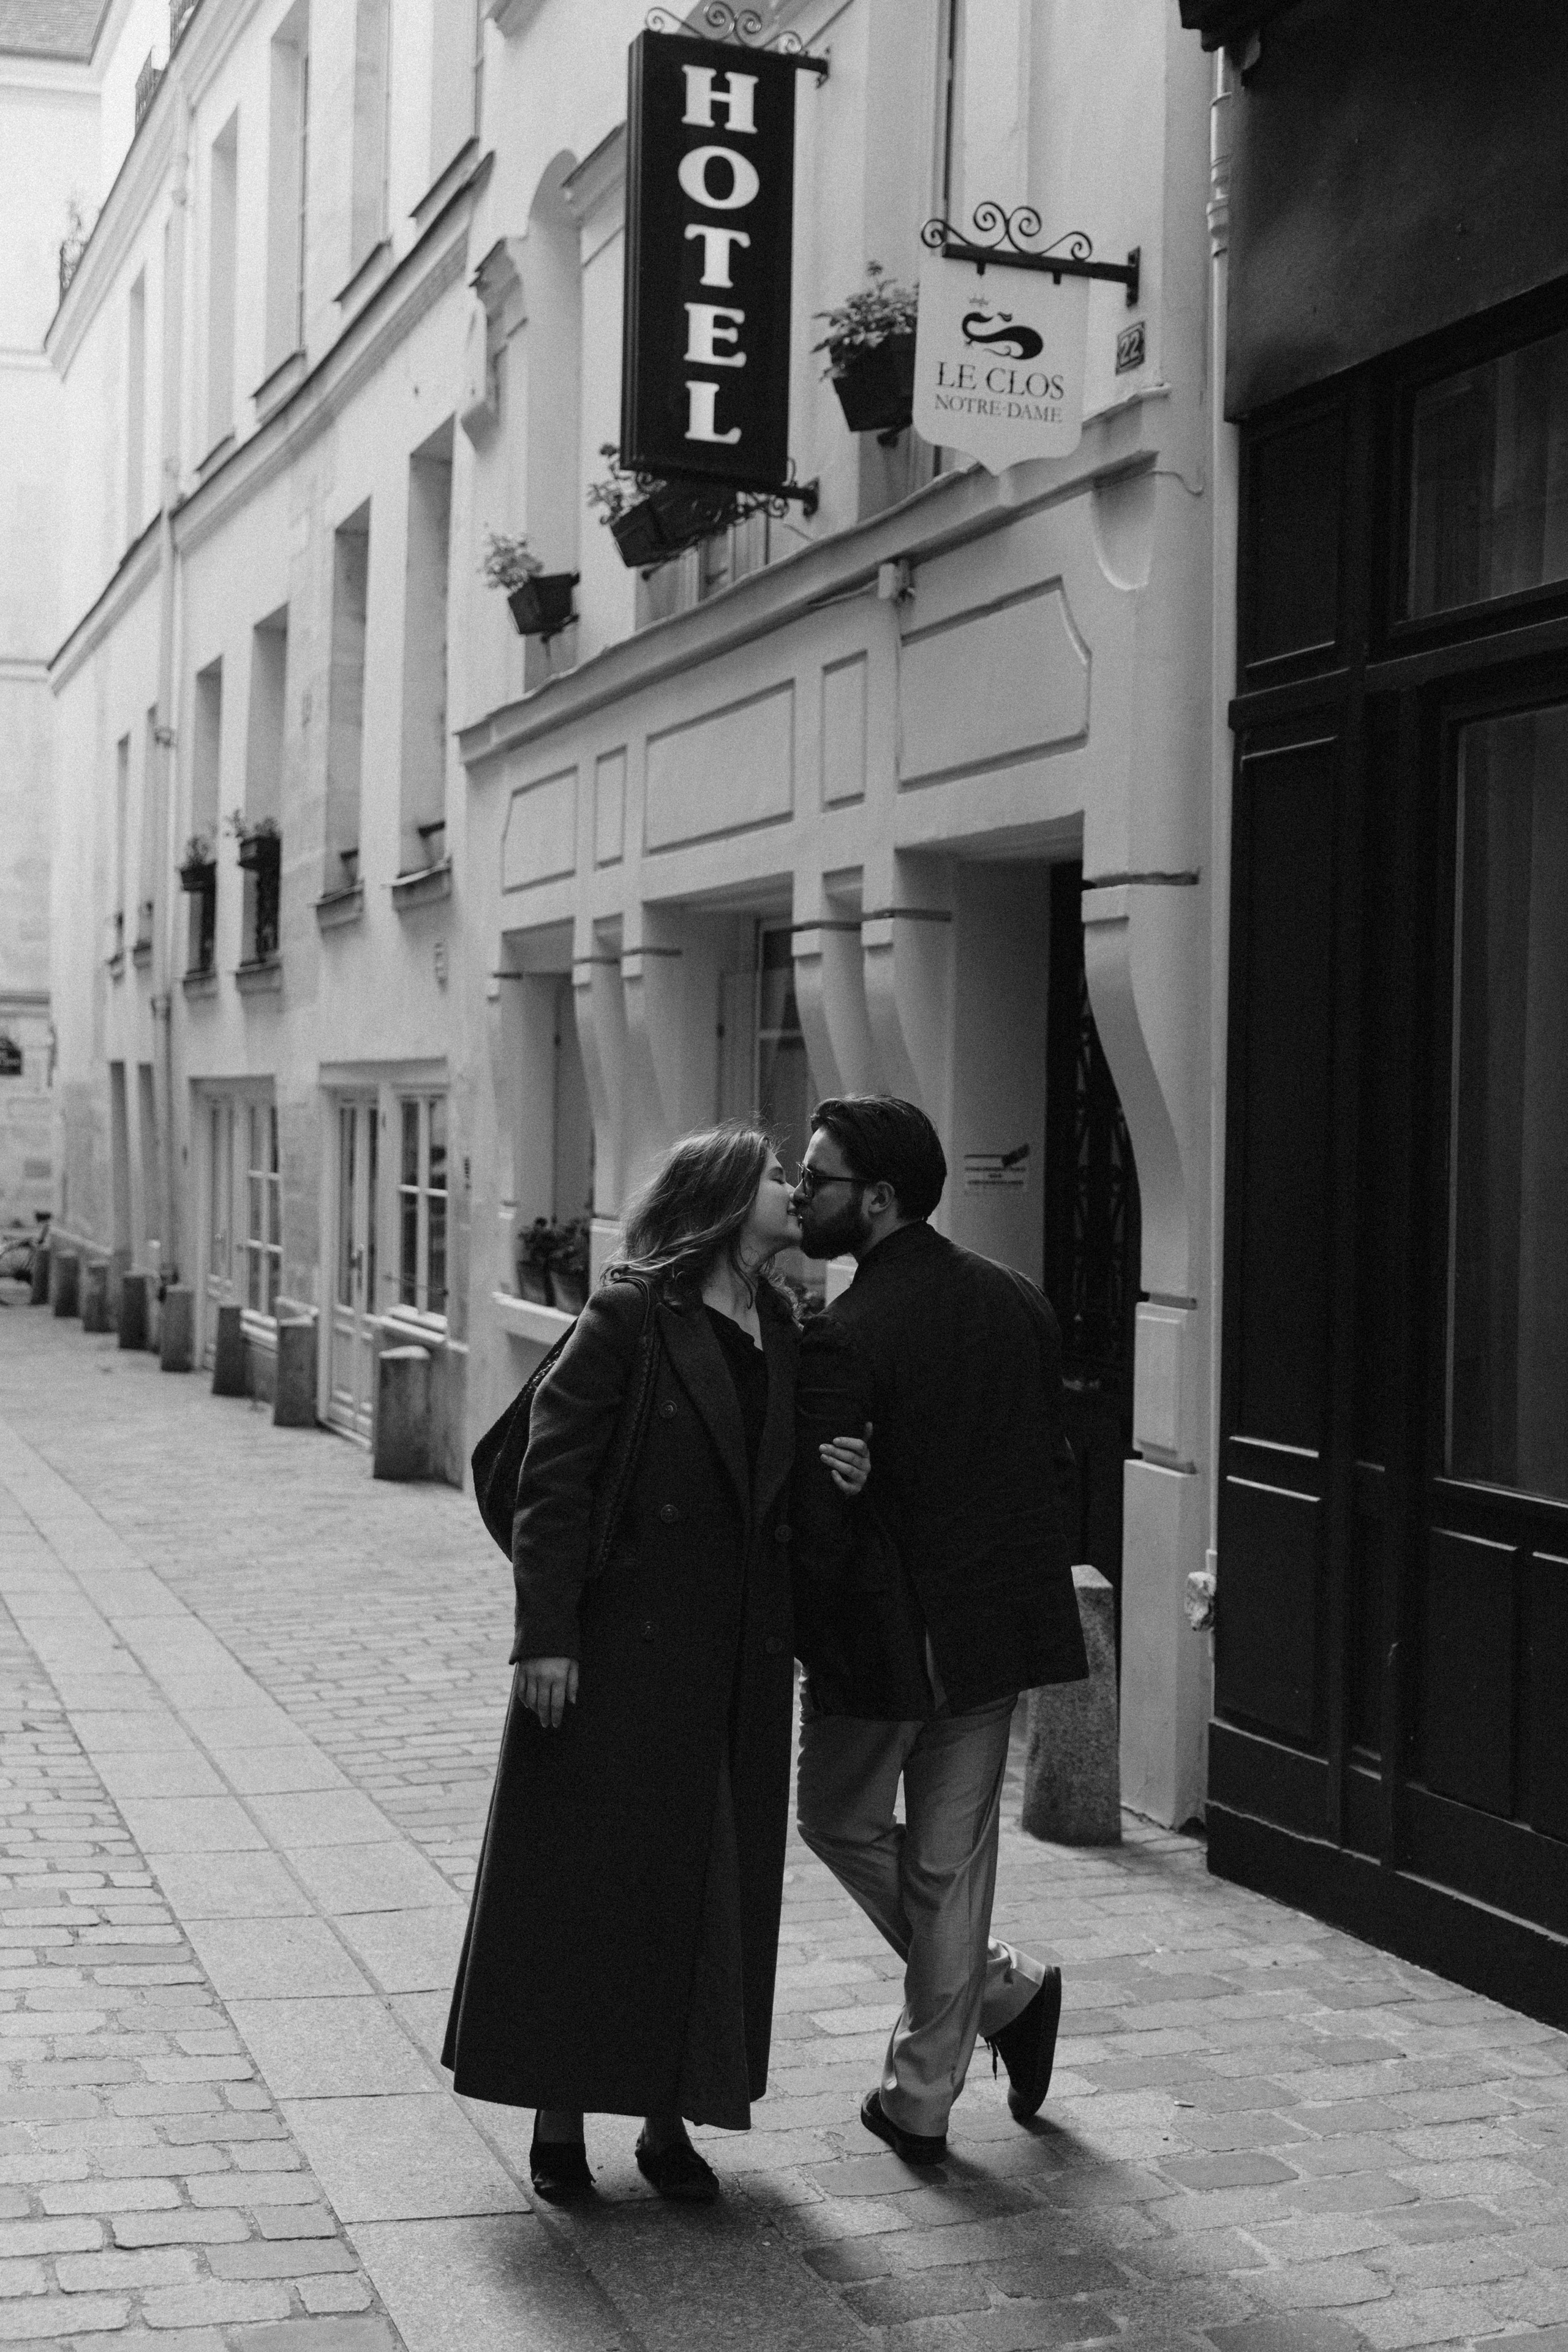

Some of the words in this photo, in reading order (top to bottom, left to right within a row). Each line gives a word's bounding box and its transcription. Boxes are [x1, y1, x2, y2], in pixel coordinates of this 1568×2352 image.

[678, 64, 760, 445] HOTEL
[1120, 331, 1141, 366] 22
[937, 361, 978, 390] LE
[986, 367, 1065, 401] CLOS
